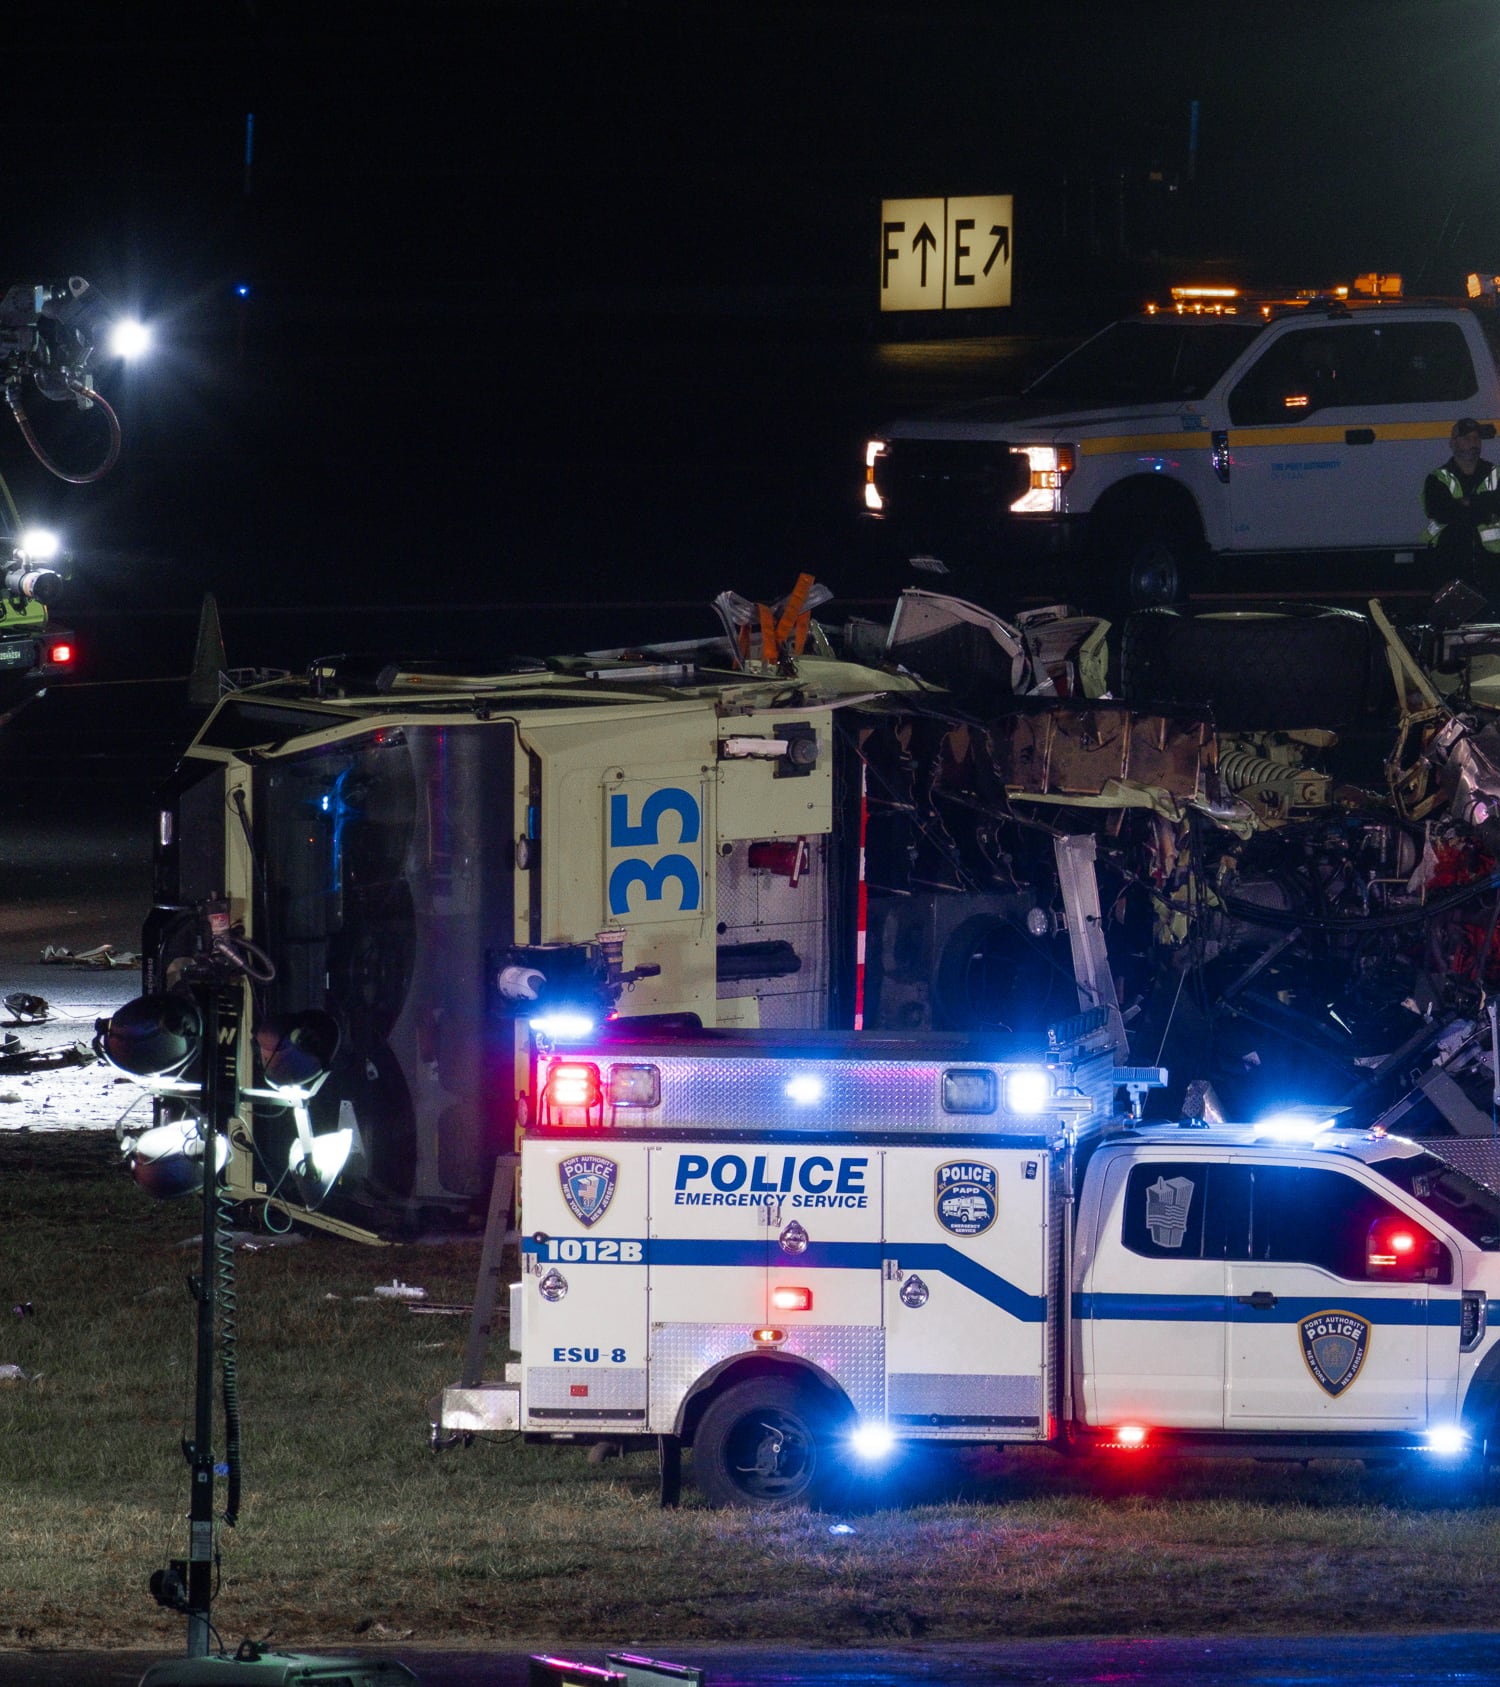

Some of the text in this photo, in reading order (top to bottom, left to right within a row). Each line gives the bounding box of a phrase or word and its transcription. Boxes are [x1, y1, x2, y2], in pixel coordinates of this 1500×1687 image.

[883, 222, 905, 289] F
[954, 219, 975, 286] E
[609, 788, 700, 915] 35
[563, 1156, 615, 1168] PORT AUTHORITY
[565, 1163, 613, 1178] POLICE
[674, 1154, 869, 1194] POLICE
[942, 1166, 992, 1182] POLICE
[563, 1183, 584, 1219] NEW YORK
[590, 1182, 615, 1222] NEW JERSEY
[674, 1192, 869, 1208] EMERGENCY SERVICE
[545, 1240, 643, 1262] 1012B
[1304, 1316, 1365, 1331] PORT AUTHORITY
[1306, 1323, 1362, 1340] POLICE
[1306, 1350, 1327, 1384] NEW YORK
[1341, 1347, 1364, 1387] NEW JERSEY
